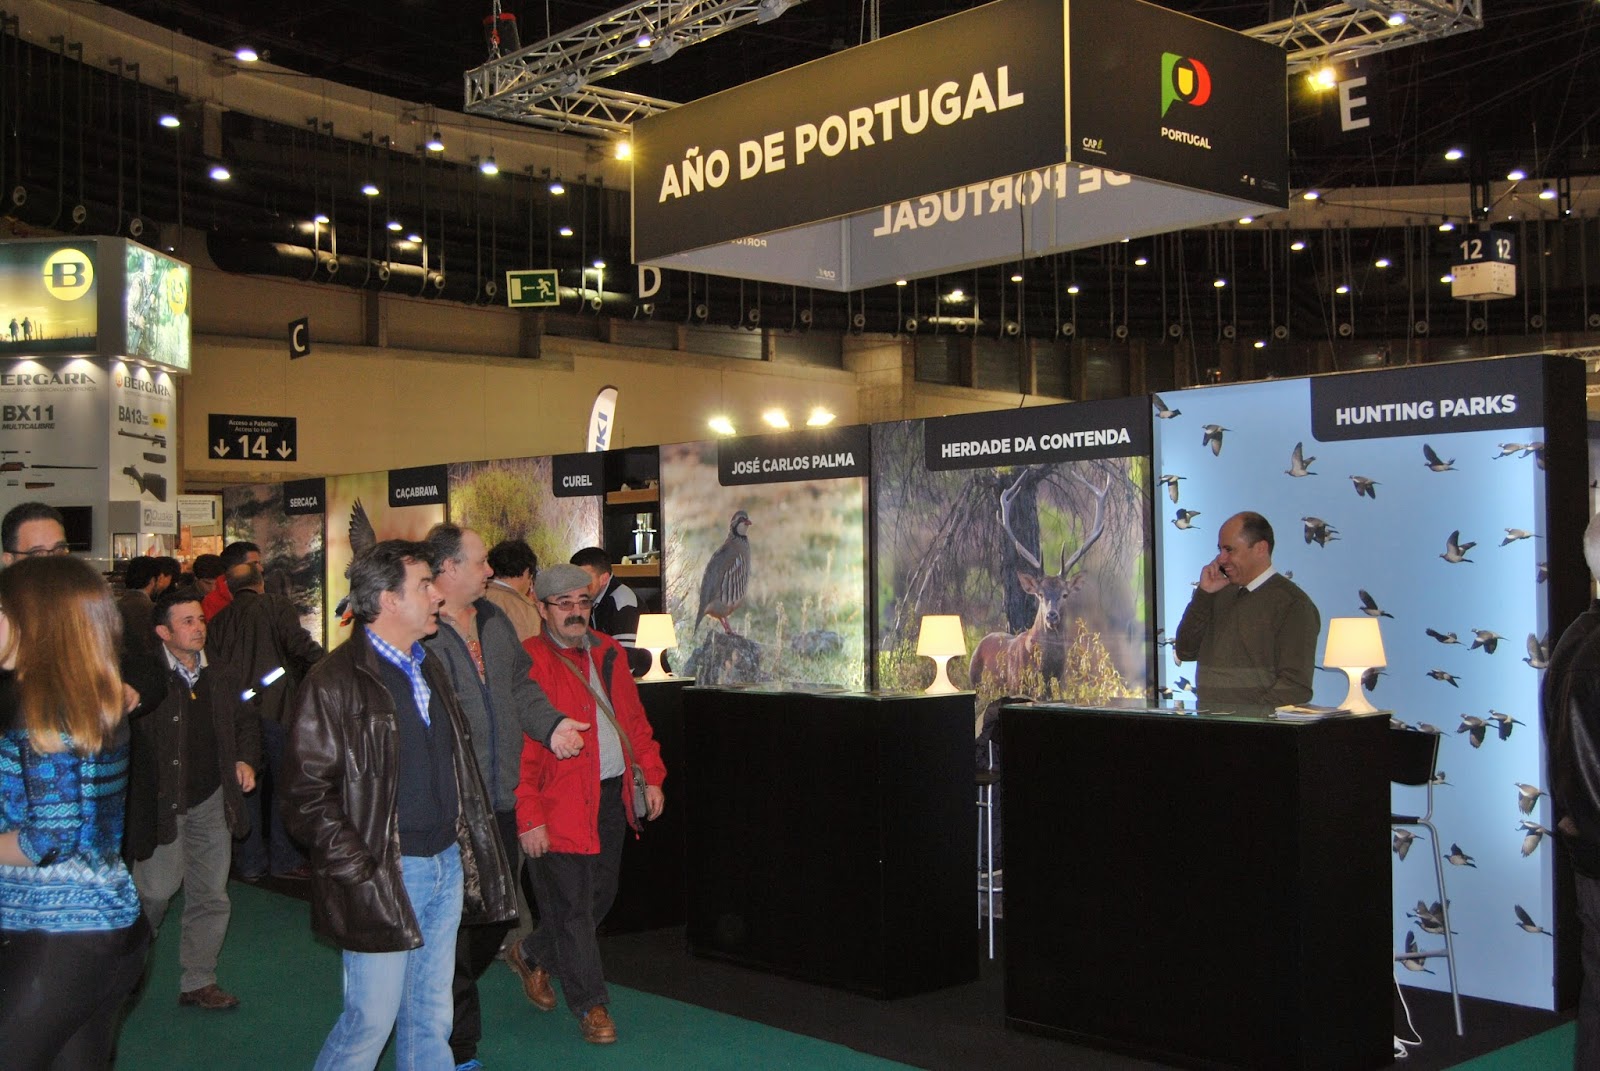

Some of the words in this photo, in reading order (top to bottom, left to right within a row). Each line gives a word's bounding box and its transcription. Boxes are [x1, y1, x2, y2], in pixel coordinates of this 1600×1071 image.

[1338, 76, 1370, 131] E
[659, 146, 730, 203] AÑO
[739, 131, 786, 180] DE
[795, 65, 1024, 165] PORTUGAL
[1161, 127, 1212, 150] PORTUGAL
[1460, 239, 1483, 260] 12
[1496, 238, 1511, 259] 12
[51, 262, 86, 288] B
[638, 265, 662, 299] D
[293, 324, 306, 352] C
[0, 373, 96, 386] ERGARA
[124, 376, 171, 397] BERGARA
[3, 405, 54, 421] BX11
[118, 405, 142, 424] BA13
[1335, 400, 1434, 426] HUNTING
[1440, 394, 1516, 418] PARKS
[2, 422, 55, 430] MULTICALIBRE
[238, 434, 269, 459] 14
[941, 438, 1011, 459] HERDADE
[1014, 435, 1036, 454] DA
[1039, 427, 1131, 450] CONTENDA
[731, 456, 760, 475] JOSÉ
[762, 454, 810, 472] CARLOS
[812, 452, 855, 469] PALMA
[562, 474, 592, 487] CUREL
[289, 496, 318, 508] SERCAÇA
[395, 485, 438, 500] CAÇABRAVA
